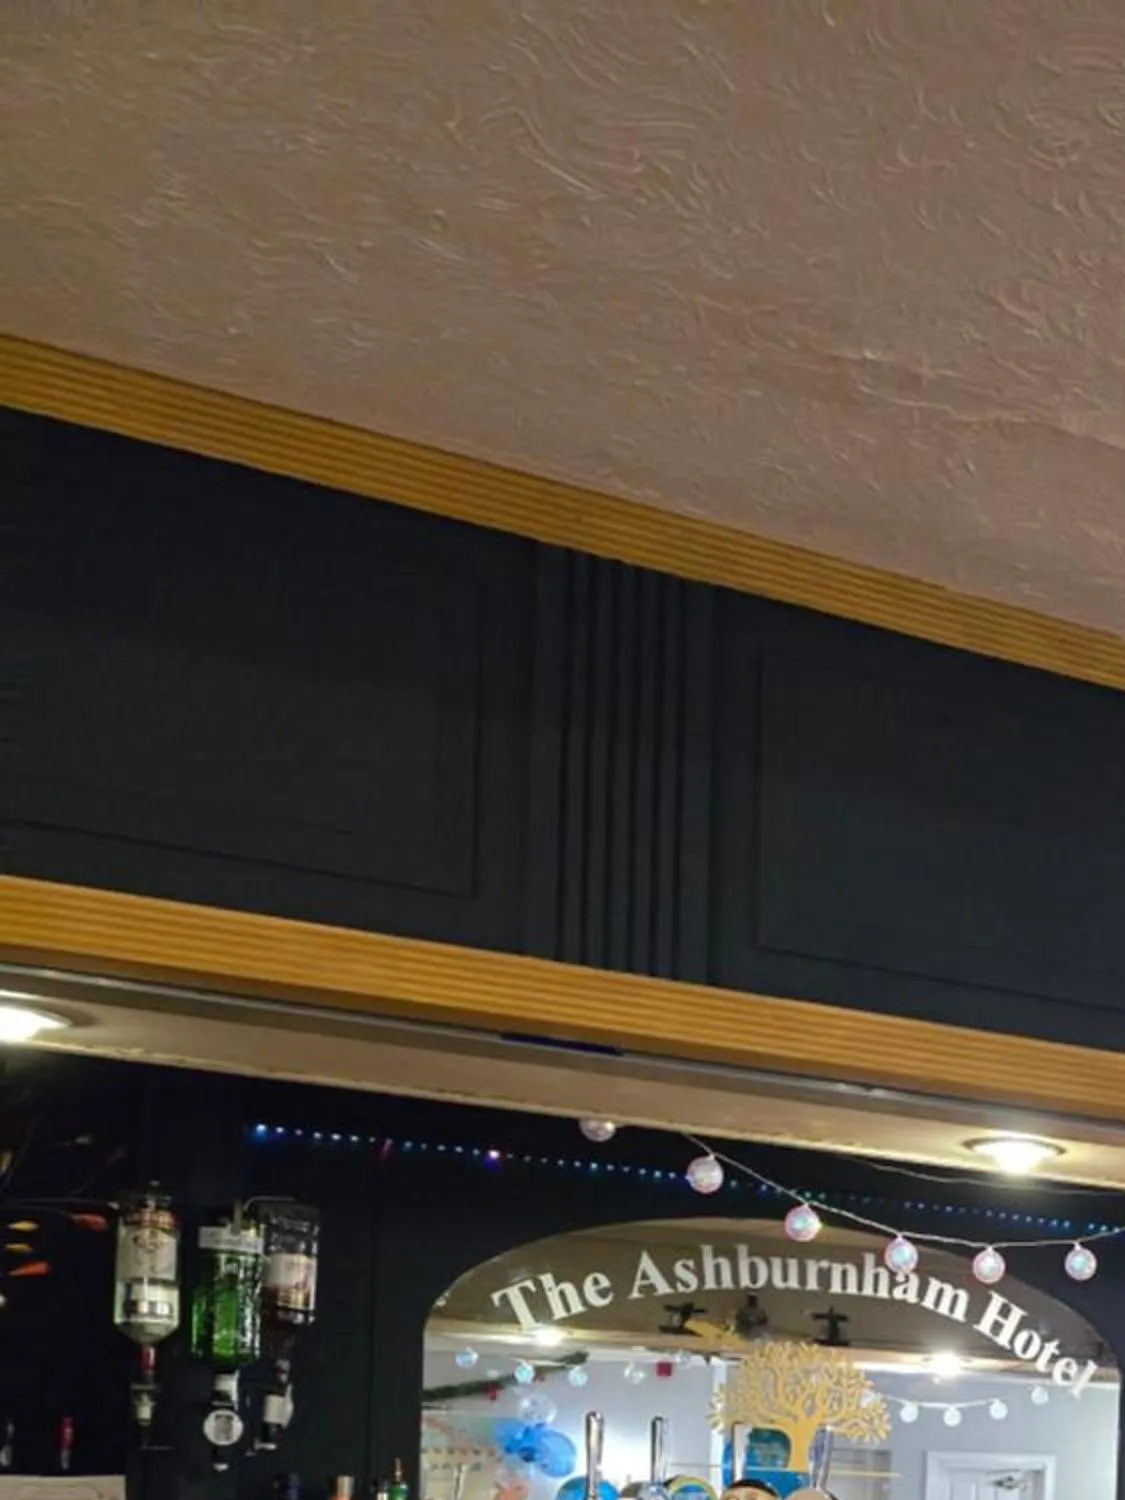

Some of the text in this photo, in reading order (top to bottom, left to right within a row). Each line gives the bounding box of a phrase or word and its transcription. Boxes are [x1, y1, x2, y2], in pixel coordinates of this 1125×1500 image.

[491, 1243, 1099, 1399] The Ashburnham Hotel
